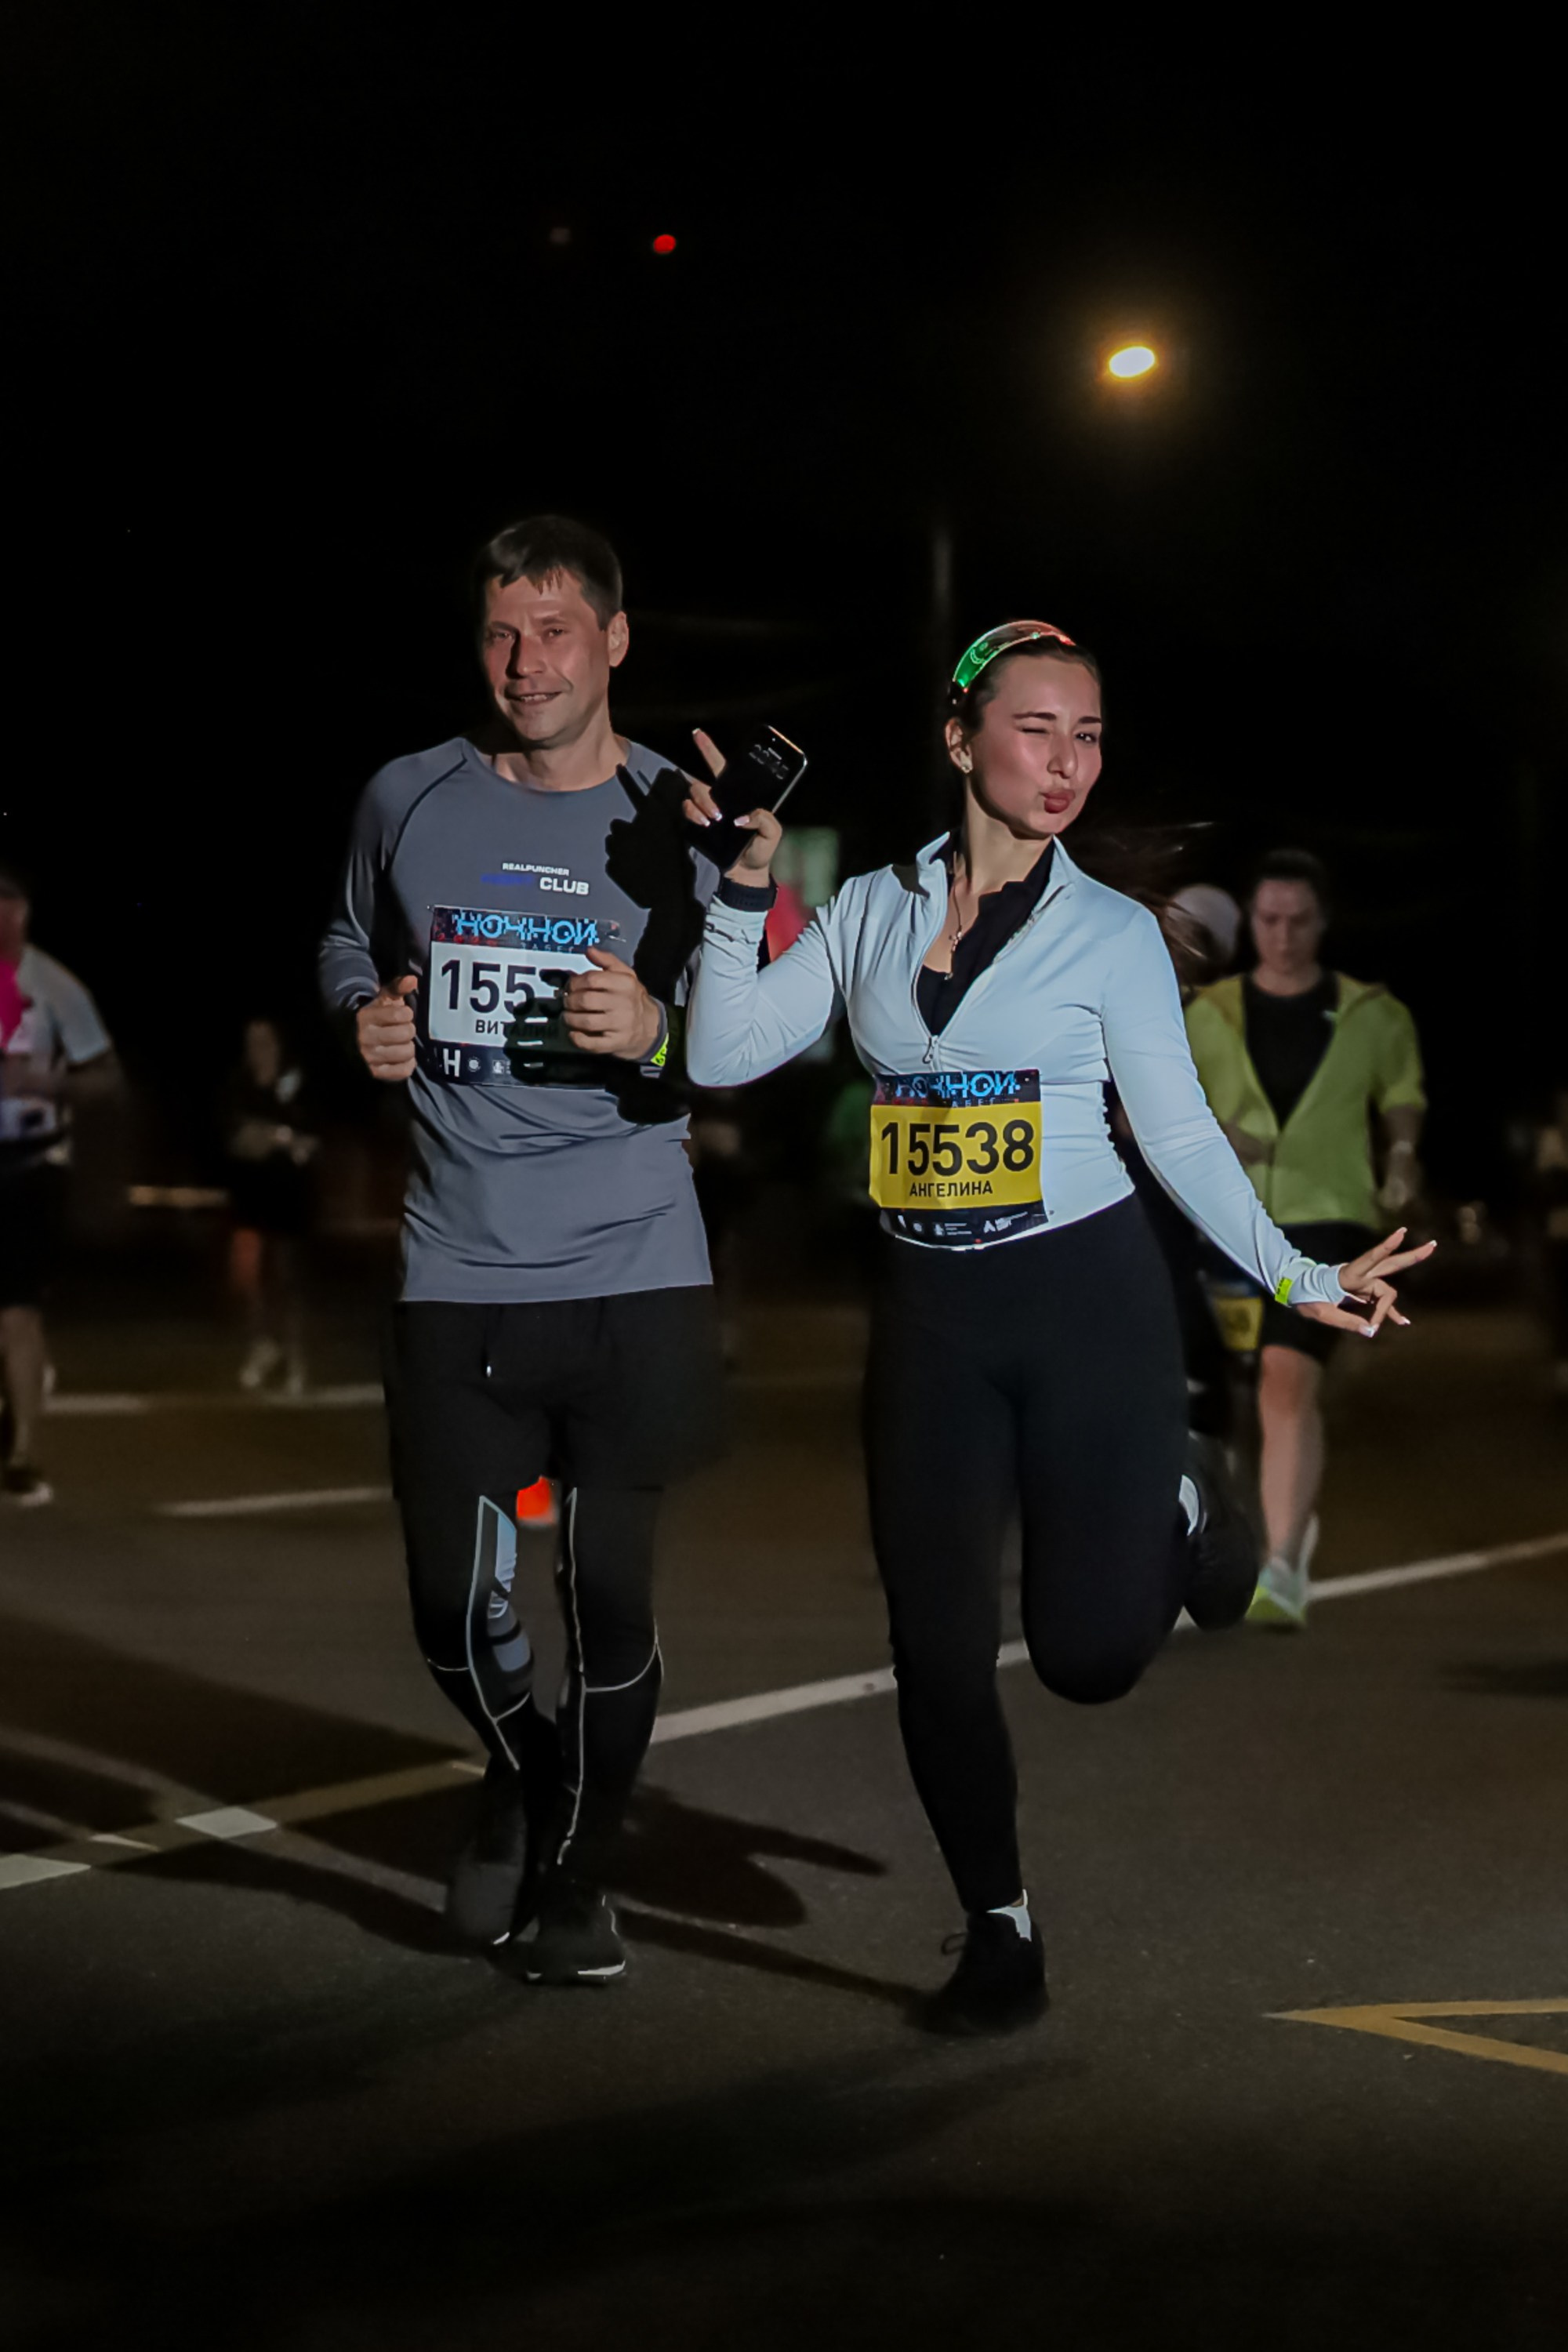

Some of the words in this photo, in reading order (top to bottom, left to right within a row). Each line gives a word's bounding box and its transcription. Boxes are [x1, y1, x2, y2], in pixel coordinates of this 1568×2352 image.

[539, 876, 590, 896] CLUB
[881, 1119, 1034, 1176] 15538
[909, 1180, 993, 1198] АНГЕЛИНА
